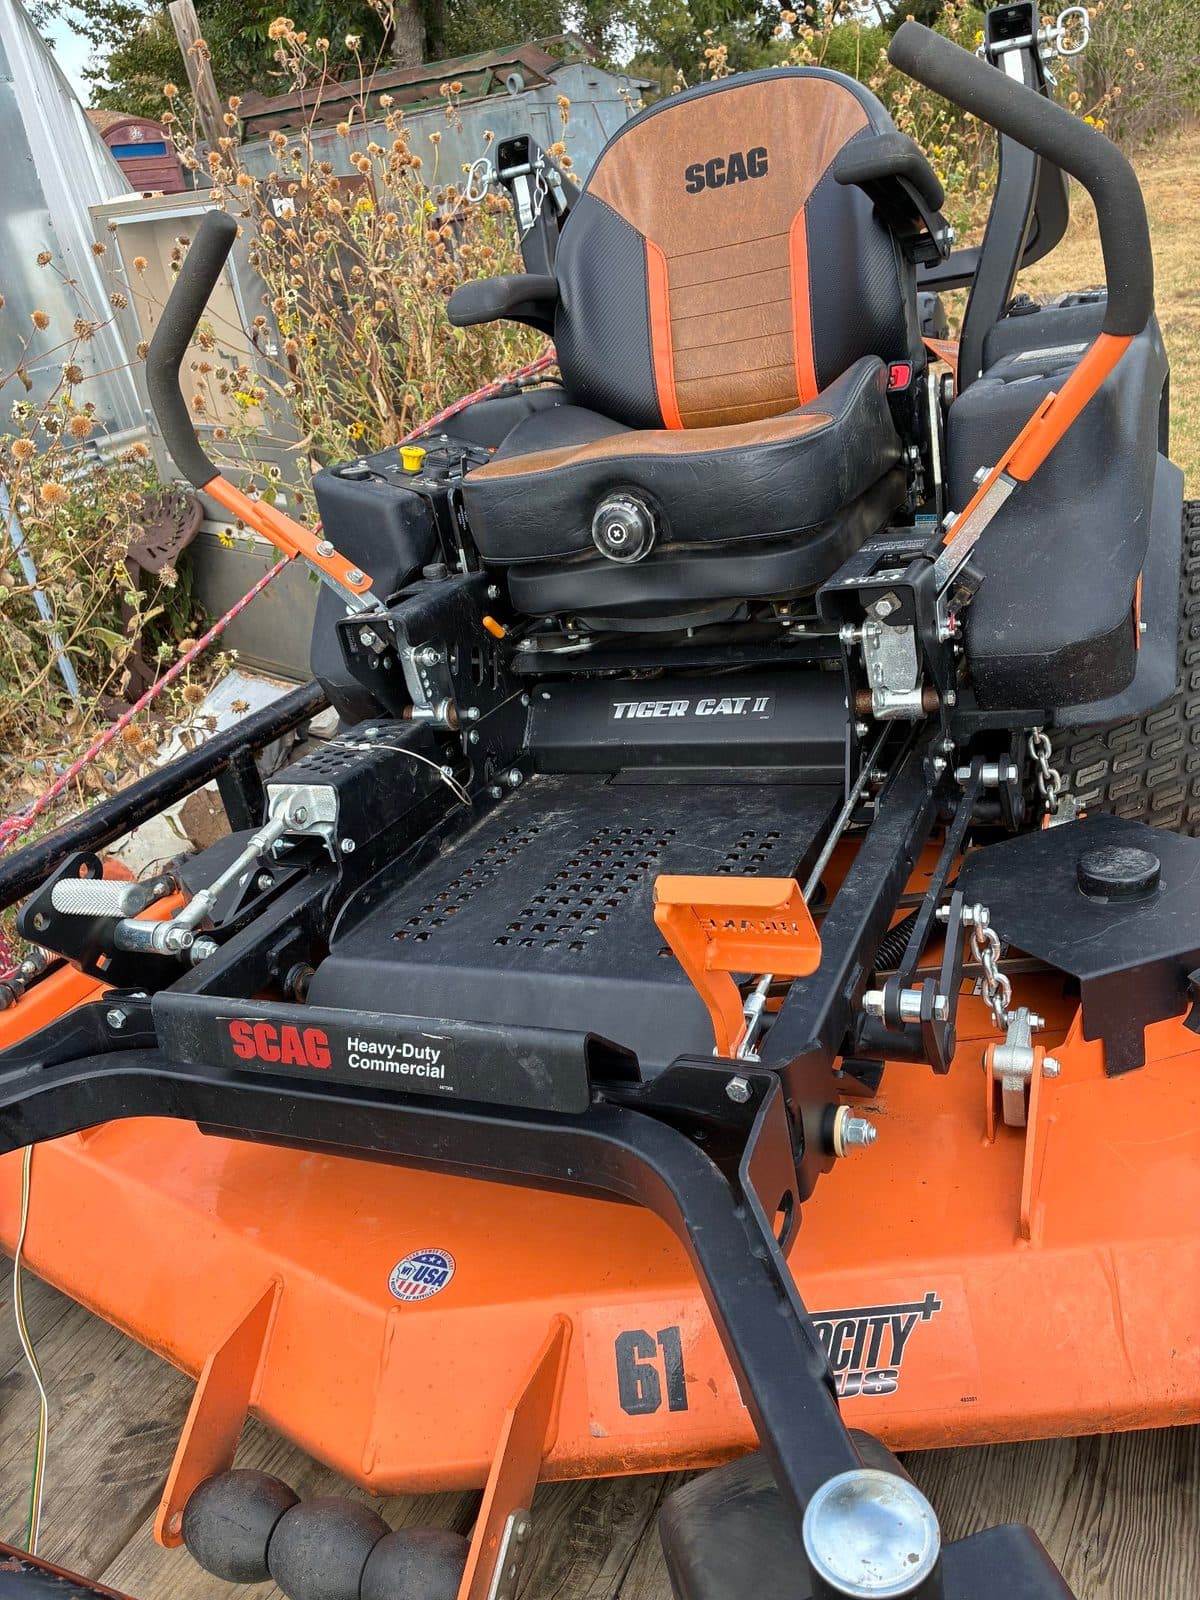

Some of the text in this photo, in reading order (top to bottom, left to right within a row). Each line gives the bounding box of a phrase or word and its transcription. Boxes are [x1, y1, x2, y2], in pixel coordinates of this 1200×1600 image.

[685, 146, 769, 194] SCAG
[613, 699, 690, 719] TIGER
[752, 697, 770, 712] II
[228, 1019, 332, 1069] SCAG
[347, 1036, 441, 1063] Heavy-Duty
[348, 1054, 445, 1079] Commercial
[412, 1265, 449, 1287] USA
[614, 1325, 689, 1416] 61
